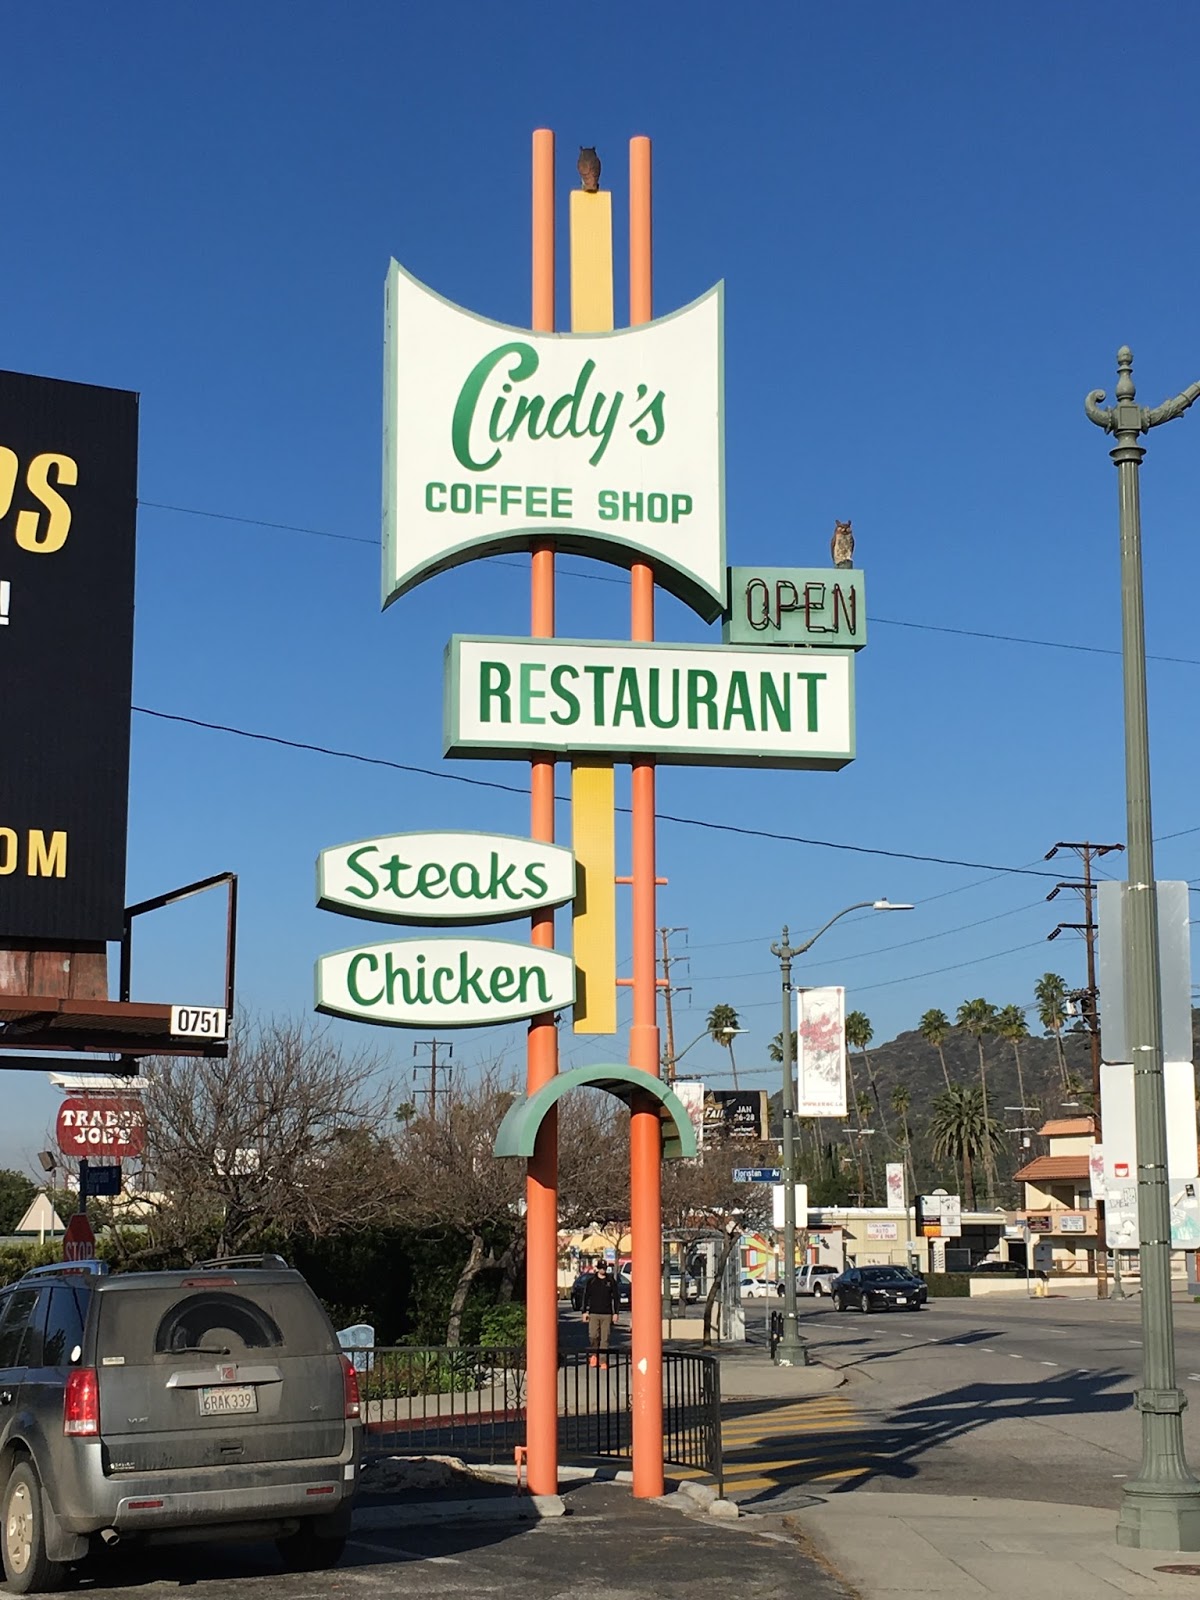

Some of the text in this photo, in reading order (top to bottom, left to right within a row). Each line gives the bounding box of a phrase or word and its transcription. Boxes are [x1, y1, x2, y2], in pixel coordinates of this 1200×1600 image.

[452, 342, 666, 472] Cindy's
[425, 482, 693, 523] COFFEE SHOP
[746, 578, 856, 635] OPEN
[479, 661, 827, 733] RESTAURANT
[345, 845, 548, 900] Steaks
[346, 950, 553, 1006] Chicken
[178, 1009, 219, 1033] 0751
[74, 1127, 132, 1145] JOE'S
[204, 1394, 251, 1409] 6RAK339
